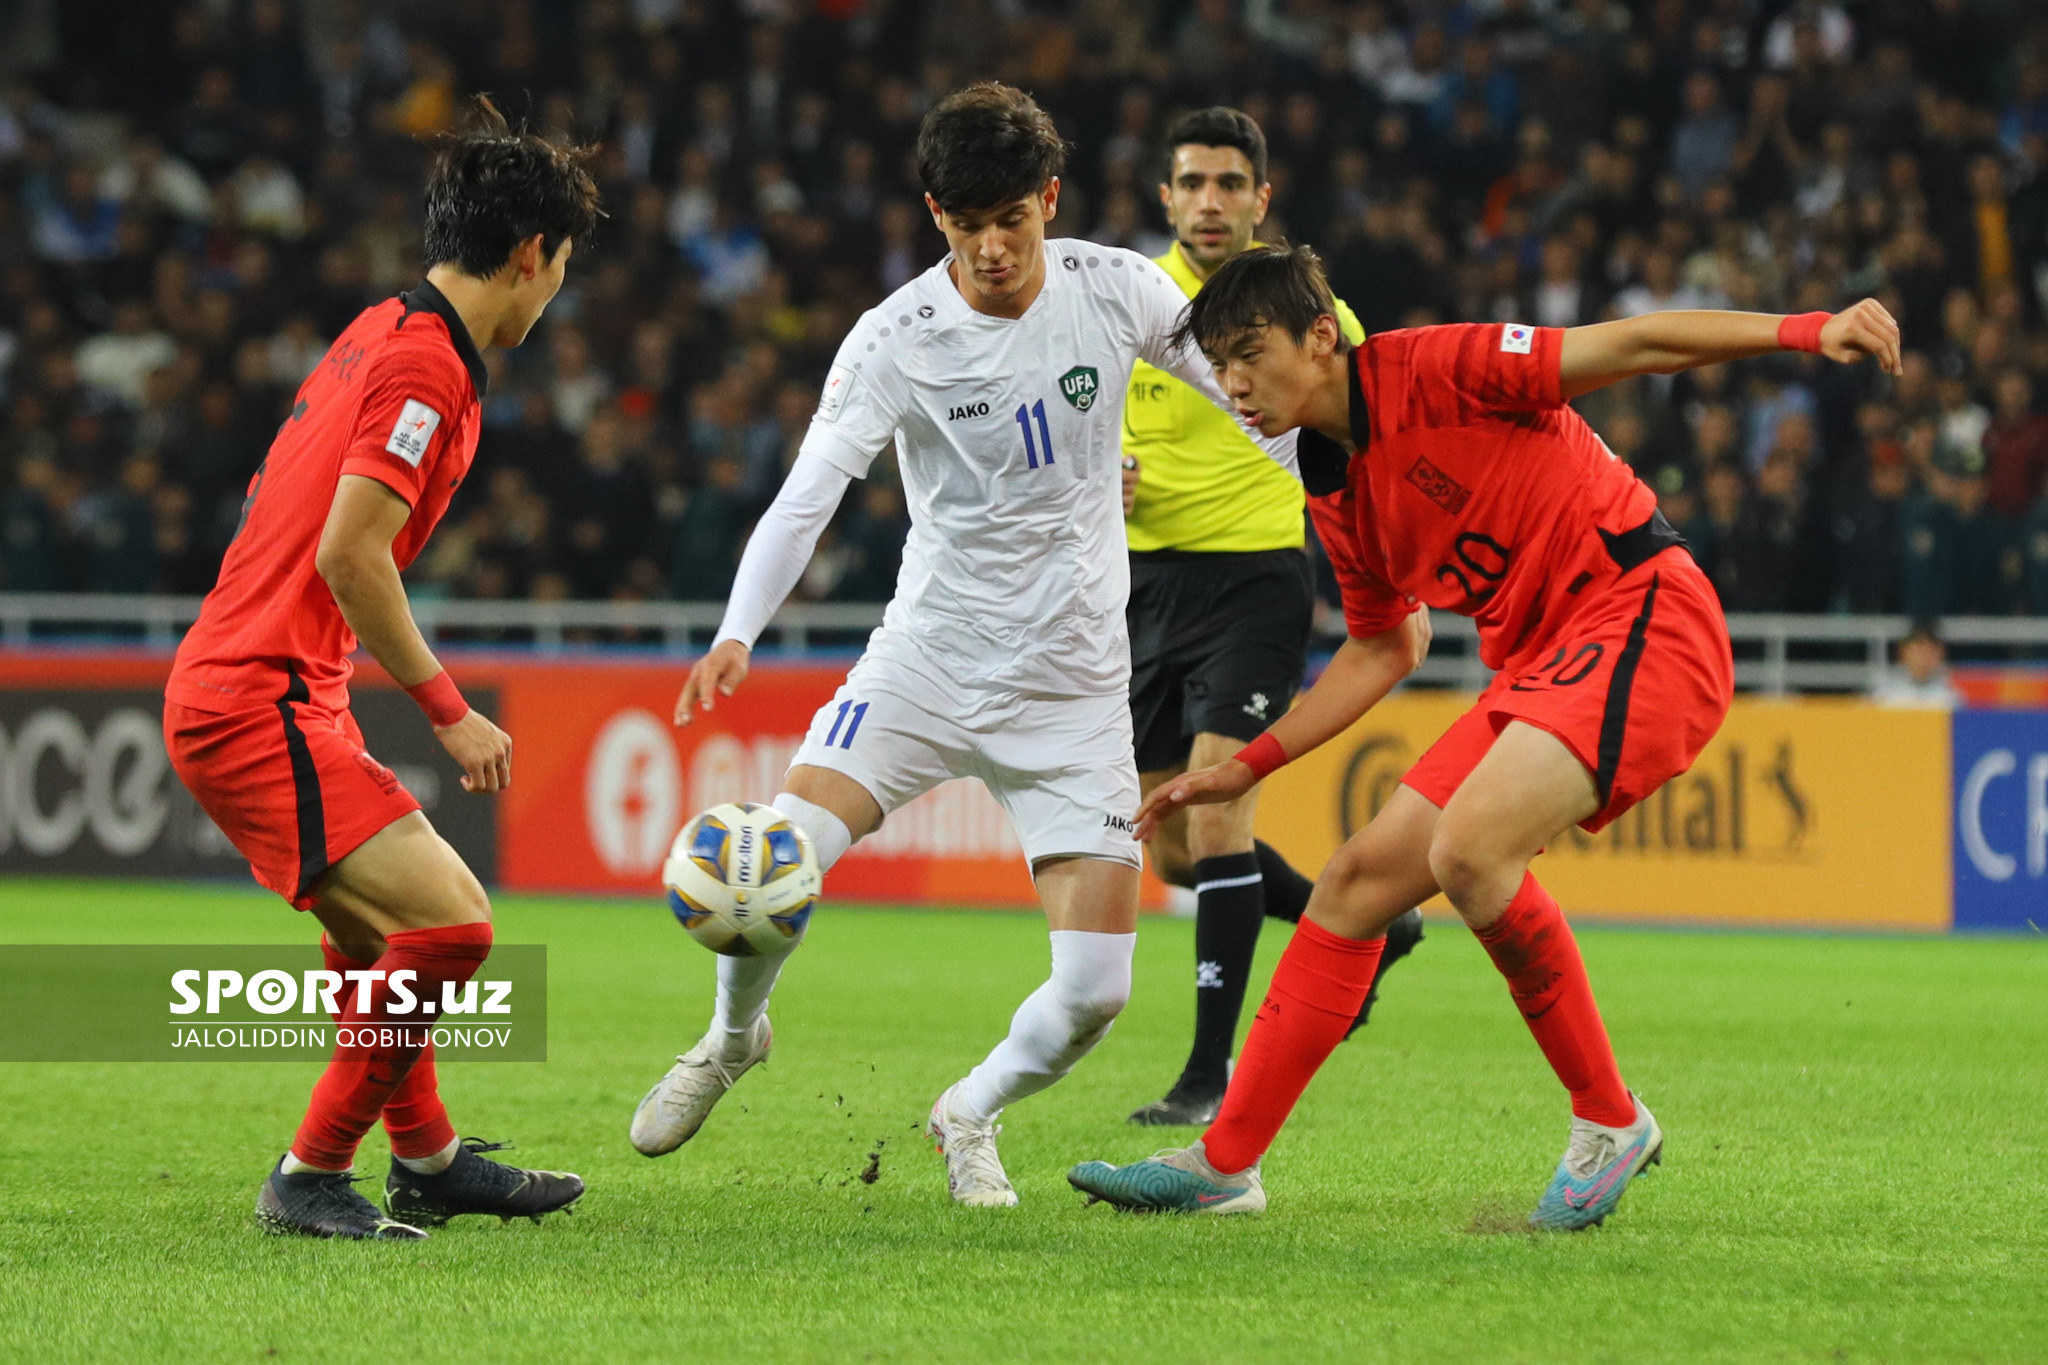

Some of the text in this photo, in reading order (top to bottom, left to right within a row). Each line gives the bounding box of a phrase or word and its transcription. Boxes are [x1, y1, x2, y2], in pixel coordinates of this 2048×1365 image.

[1064, 372, 1096, 395] UFA
[948, 402, 990, 421] JAKO
[1015, 398, 1055, 469] 11
[1436, 531, 1510, 601] 20
[824, 699, 870, 750] 11
[0, 708, 171, 859] ce
[1103, 814, 1134, 833] JAKO
[737, 825, 754, 883] molten
